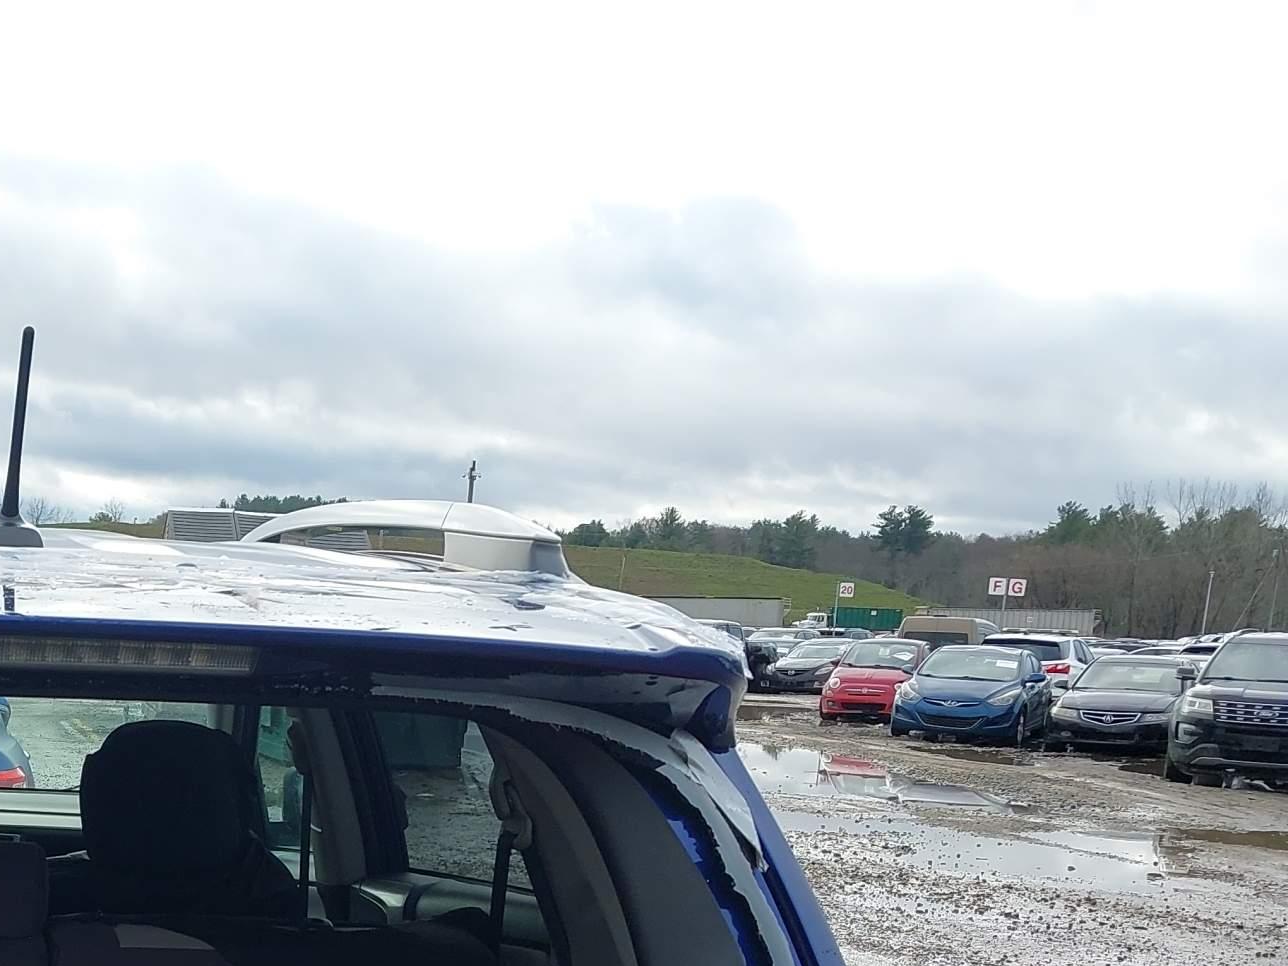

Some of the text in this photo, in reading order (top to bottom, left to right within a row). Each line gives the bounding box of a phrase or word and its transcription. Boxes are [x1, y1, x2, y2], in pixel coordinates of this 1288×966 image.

[841, 586, 853, 594] 20
[993, 580, 1023, 594] F G
